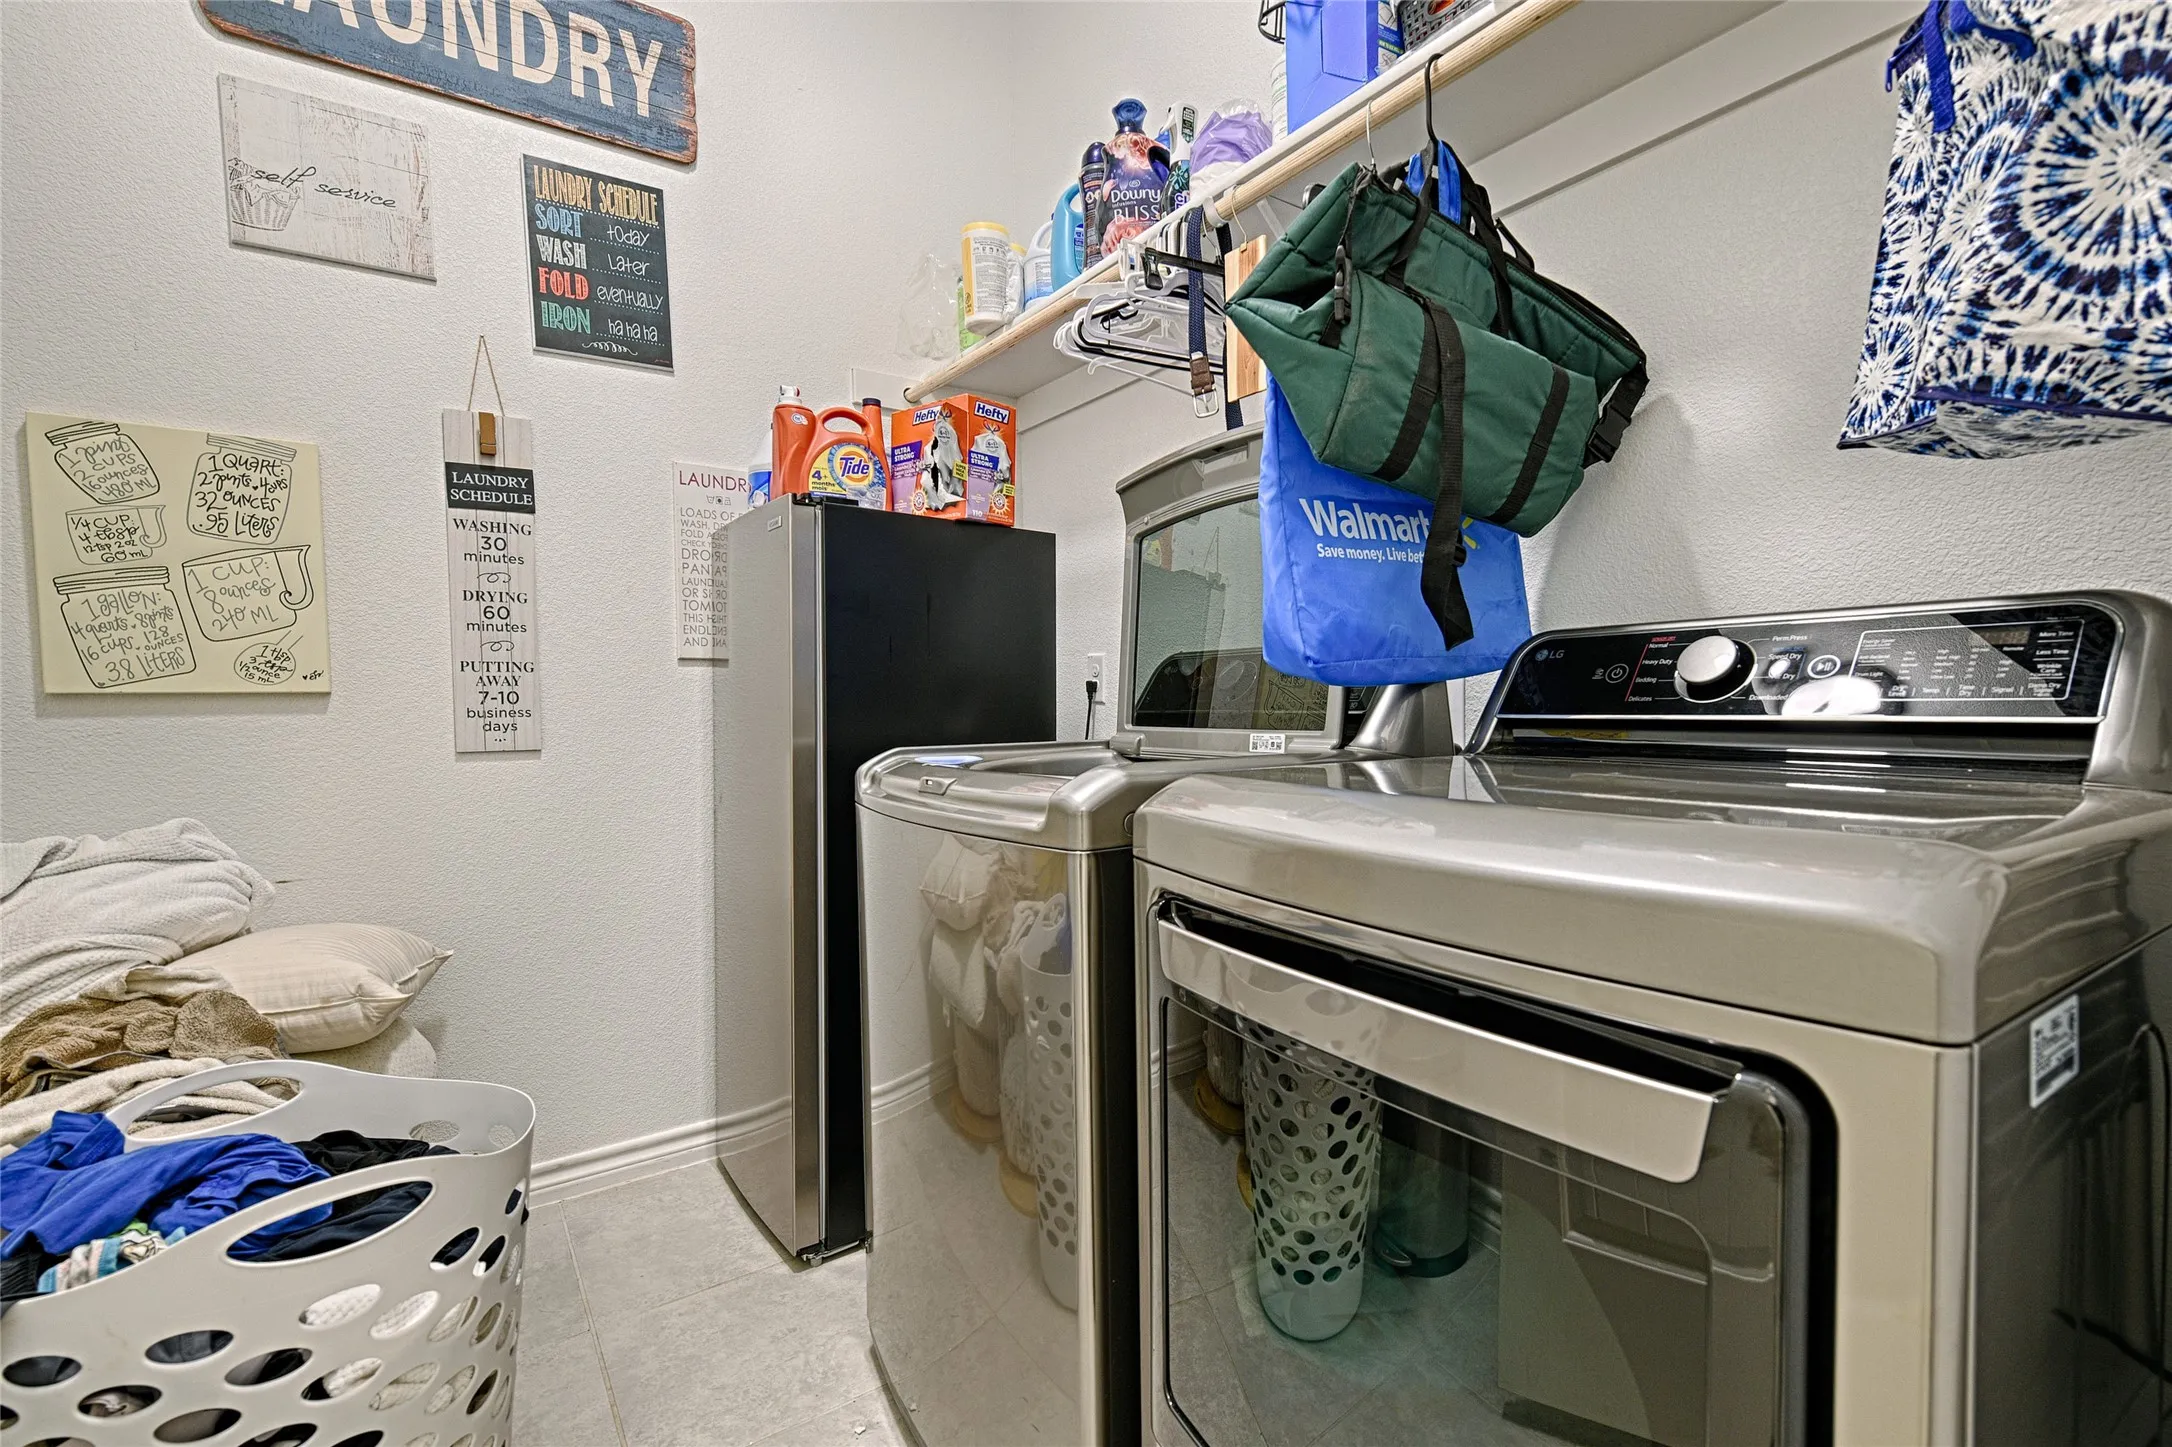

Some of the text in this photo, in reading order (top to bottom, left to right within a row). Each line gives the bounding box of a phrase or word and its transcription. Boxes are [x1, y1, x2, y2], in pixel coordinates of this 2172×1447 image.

[251, 166, 396, 208] self service
[533, 165, 659, 226] LAUNDRY SCHEDULE
[1111, 189, 1160, 203] Downy
[1114, 205, 1160, 224] BLISS
[534, 203, 650, 247] SORT today
[536, 234, 587, 269] WASH
[538, 267, 590, 301] FOLD
[541, 300, 592, 335] IRON
[914, 409, 940, 423] Hefty
[976, 403, 1008, 421] Hefty
[894, 446, 911, 455] ULTRA
[894, 452, 915, 462] STRONG
[970, 452, 989, 461] ULTRA
[208, 455, 224, 473] 1
[840, 457, 870, 478] Tide
[970, 458, 994, 468] STRONG
[197, 472, 213, 487] 2
[451, 471, 529, 489] LAUNDRY
[679, 470, 752, 493] LAUNDR
[195, 491, 228, 512] 32
[450, 488, 534, 506] SCHEDULE
[680, 507, 717, 520] LOADS
[453, 518, 532, 536] WASHING
[1299, 498, 1431, 544] Walmart
[680, 528, 704, 538] FOLD
[481, 536, 507, 551] 30
[463, 551, 525, 565] minutes
[681, 548, 713, 562] DRO
[1316, 543, 1425, 563] Save money. Live bet
[682, 562, 713, 575] PAN
[682, 577, 714, 587] LAUND
[204, 578, 276, 614] 8 ounces
[463, 590, 528, 604] DRYING
[682, 587, 699, 598] OR
[483, 605, 510, 620] 60
[683, 613, 703, 623] THIS
[466, 620, 527, 633] minutes
[683, 625, 712, 635] ENDL
[683, 637, 709, 647] AND
[1549, 650, 1565, 659] LG
[460, 660, 535, 673] PUTTING
[475, 675, 521, 687] AWAY
[478, 691, 520, 705] 7-10
[466, 707, 532, 719] business
[482, 720, 518, 734] days
